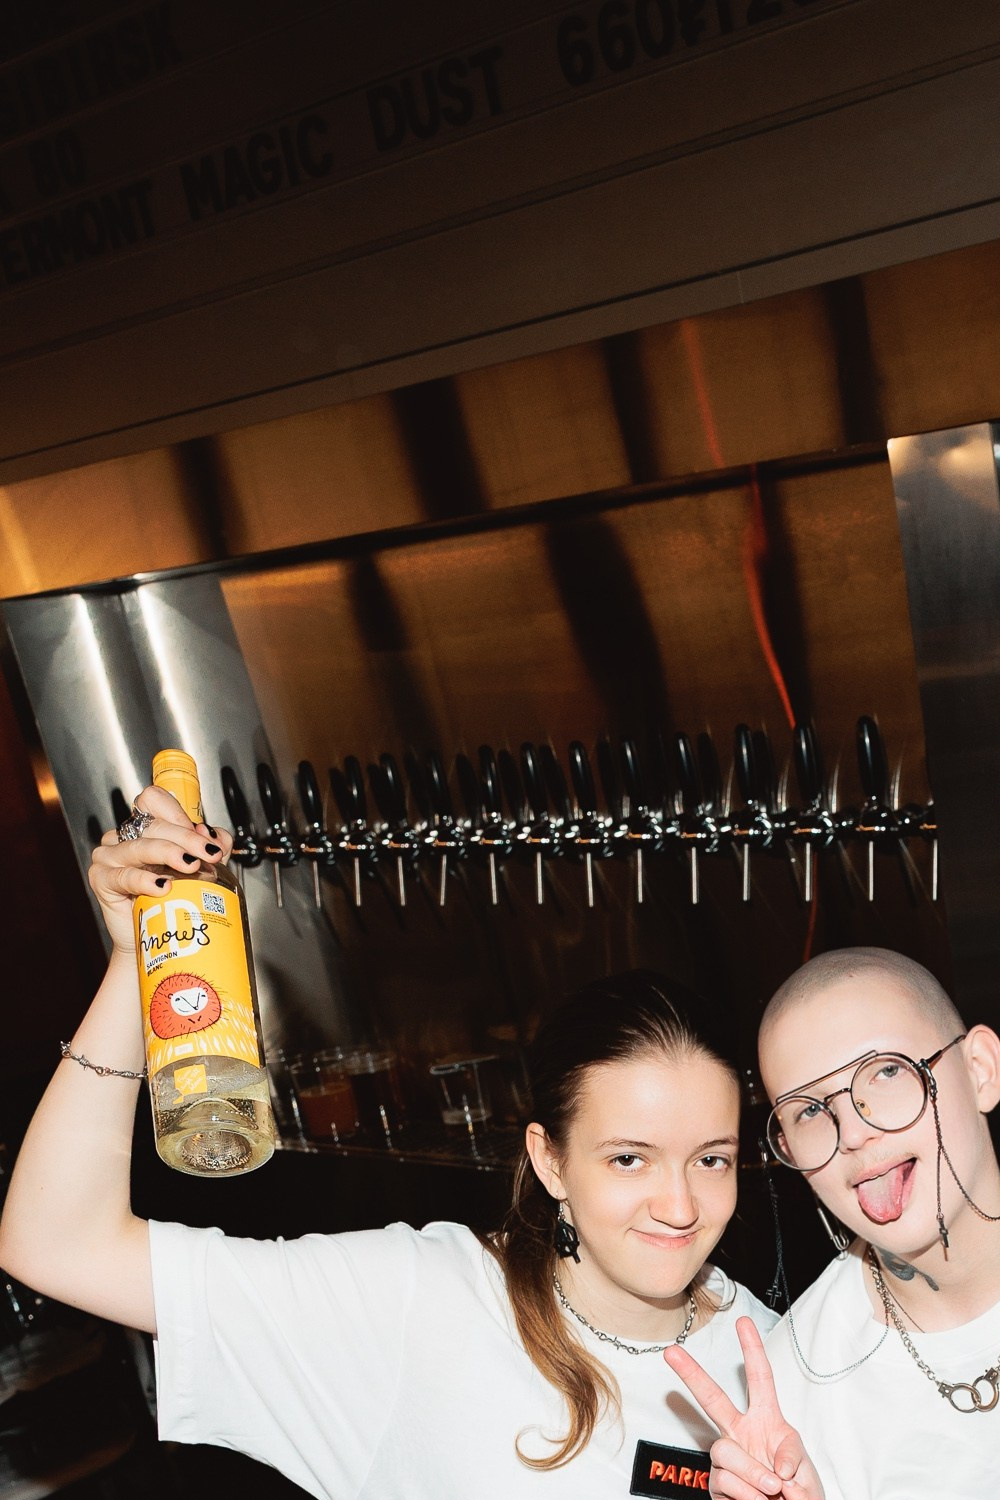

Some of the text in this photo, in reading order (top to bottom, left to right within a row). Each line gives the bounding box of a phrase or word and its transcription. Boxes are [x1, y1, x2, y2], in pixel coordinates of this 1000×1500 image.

[179, 114, 335, 222] MAGIC
[366, 45, 504, 153] DUST
[146, 951, 178, 971] SAUVIGNON
[146, 963, 164, 978] BLANC
[649, 1460, 710, 1491] PARK
